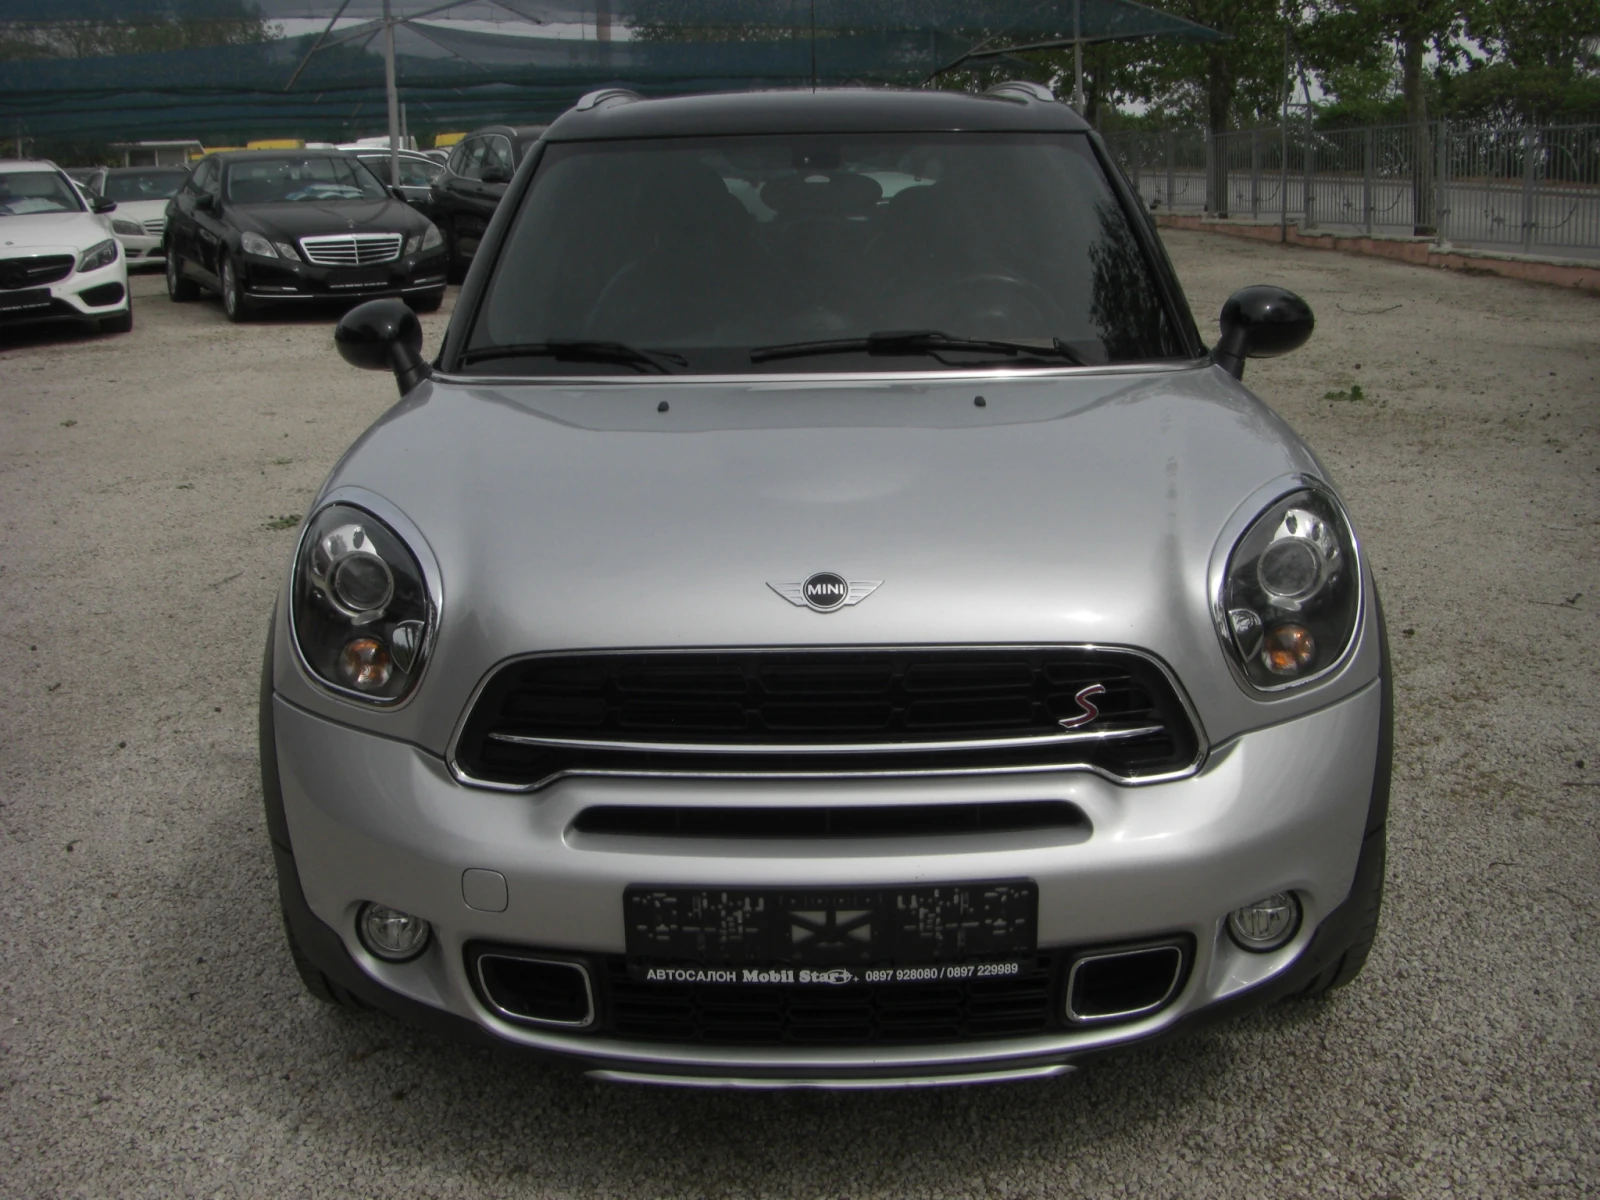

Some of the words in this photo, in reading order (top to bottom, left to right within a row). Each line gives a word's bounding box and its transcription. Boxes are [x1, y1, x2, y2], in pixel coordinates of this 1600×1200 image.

[807, 583, 844, 596] MINI
[1058, 683, 1106, 729] S
[646, 968, 737, 983] АВТОСАЛОН
[742, 969, 795, 983] Mobil
[865, 970, 893, 982] 0897
[896, 967, 938, 981] 928080
[946, 965, 975, 978] 0897
[977, 962, 1019, 976] 229989
